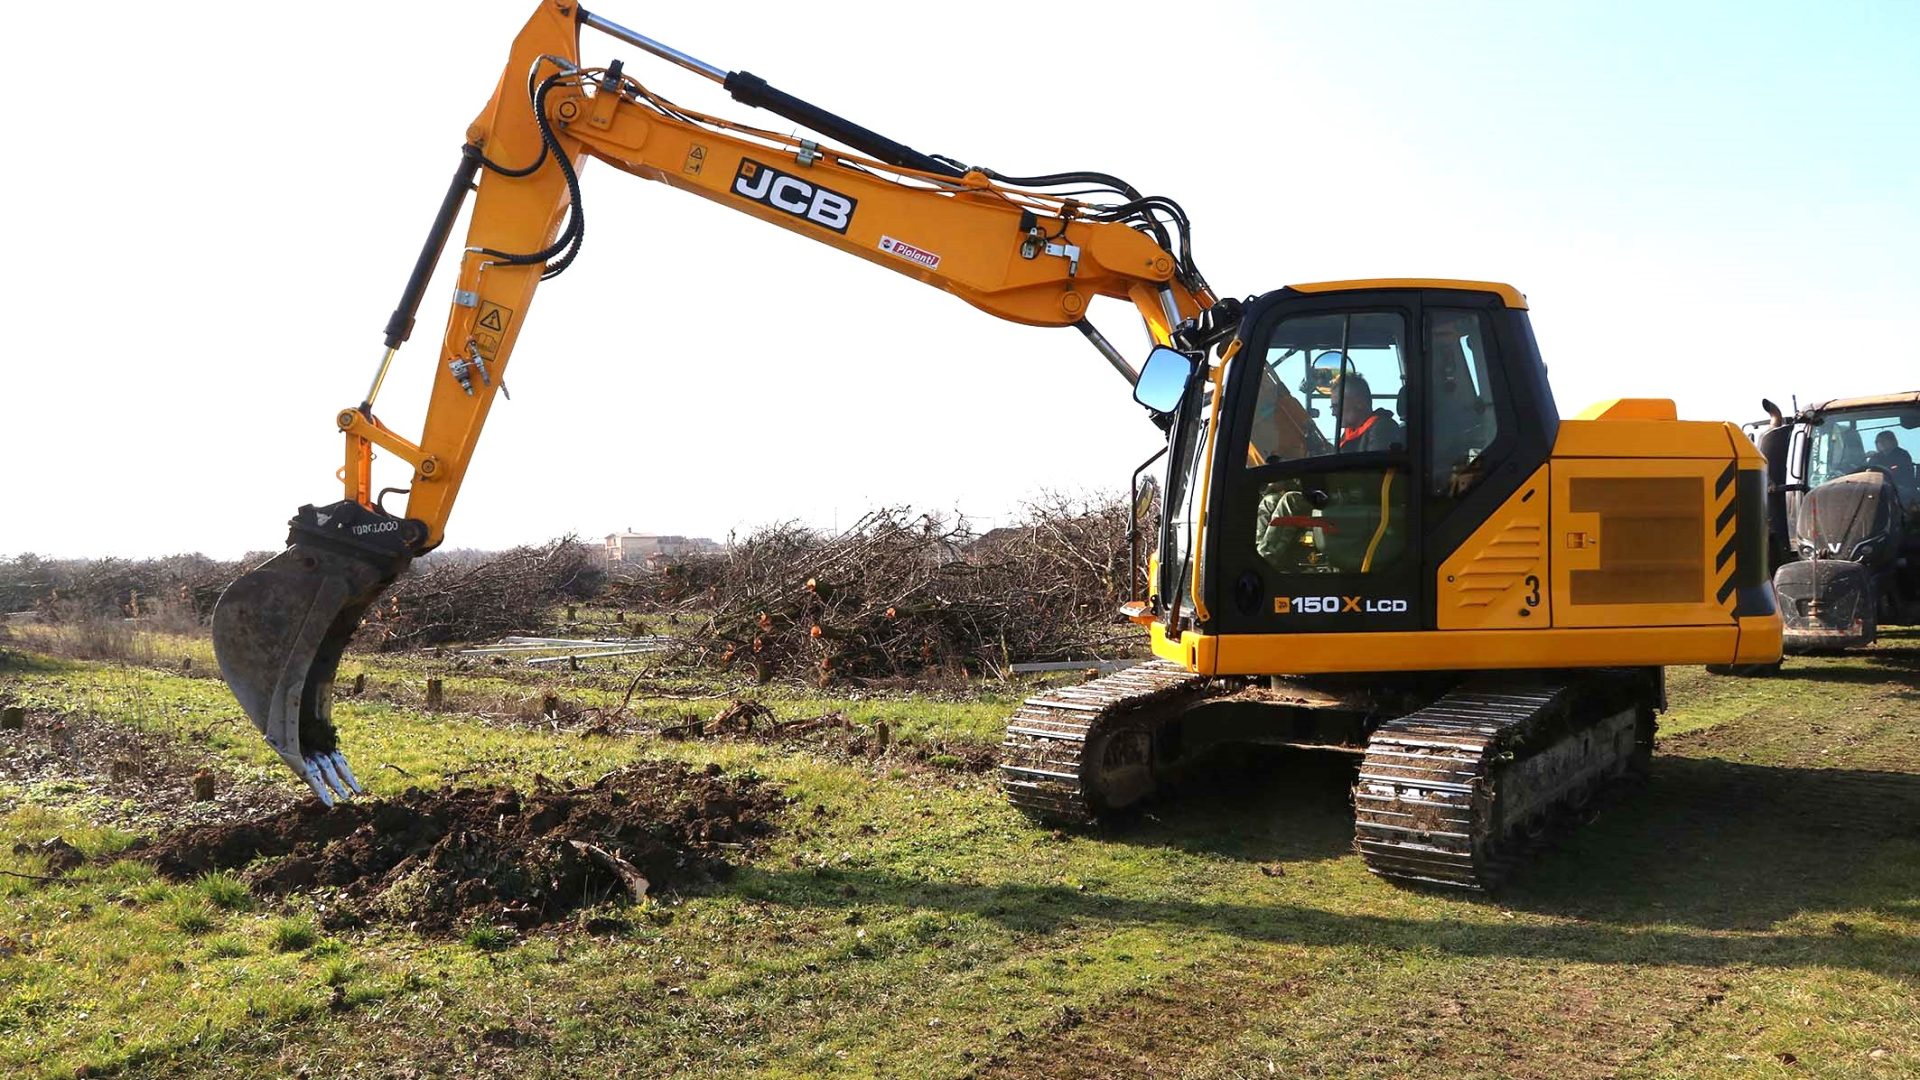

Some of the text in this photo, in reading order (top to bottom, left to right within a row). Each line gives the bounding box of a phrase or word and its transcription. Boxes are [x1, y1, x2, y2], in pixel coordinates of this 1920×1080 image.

[736, 168, 851, 230] JCB
[896, 244, 936, 265] Piolanti
[1525, 575, 1540, 607] 3
[1366, 599, 1407, 612] LCD
